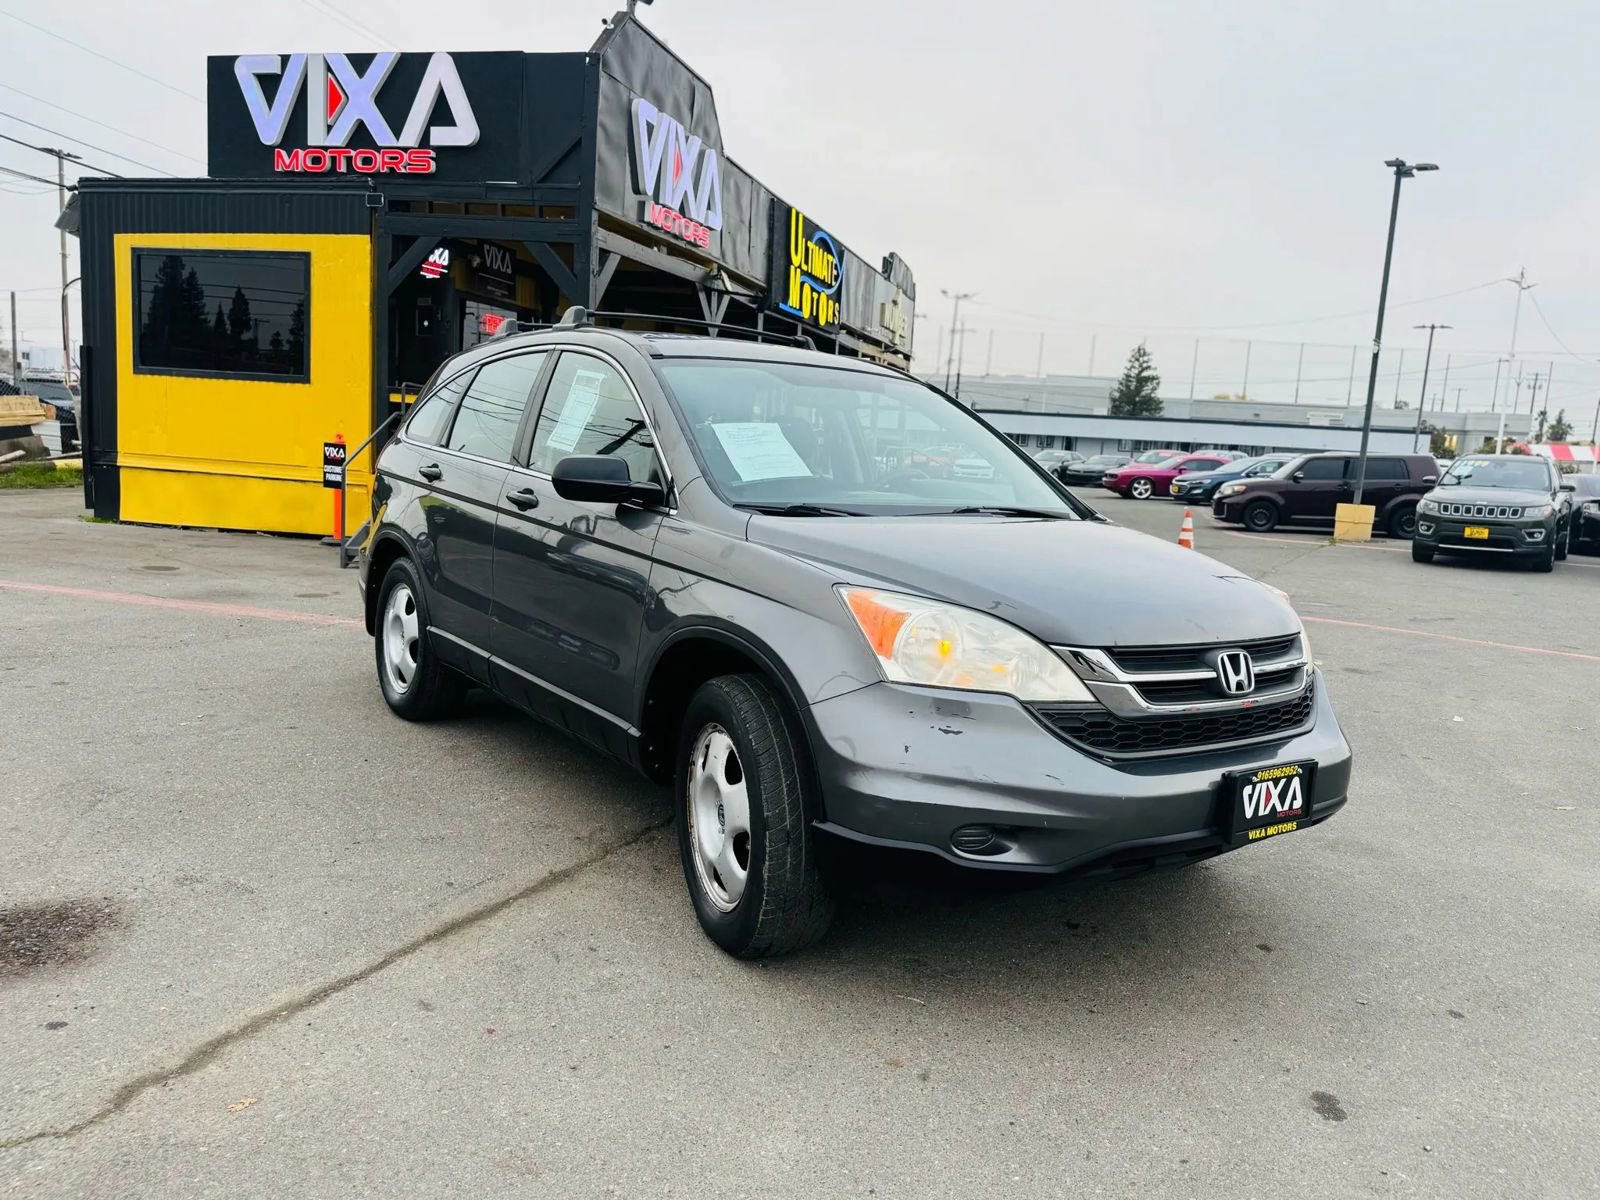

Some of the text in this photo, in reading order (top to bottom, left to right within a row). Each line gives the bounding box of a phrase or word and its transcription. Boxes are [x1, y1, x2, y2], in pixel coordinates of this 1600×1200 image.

[234, 51, 481, 147] VIXA
[274, 148, 436, 174] MOTORS
[631, 98, 723, 231] VIXA
[650, 203, 711, 249] MOTORS
[483, 243, 513, 274] VIXA
[324, 447, 345, 457] VIXA
[1242, 776, 1303, 819] VIXA
[1277, 808, 1303, 818] MOTORS
[1248, 821, 1297, 840] VIXA MOTORS
